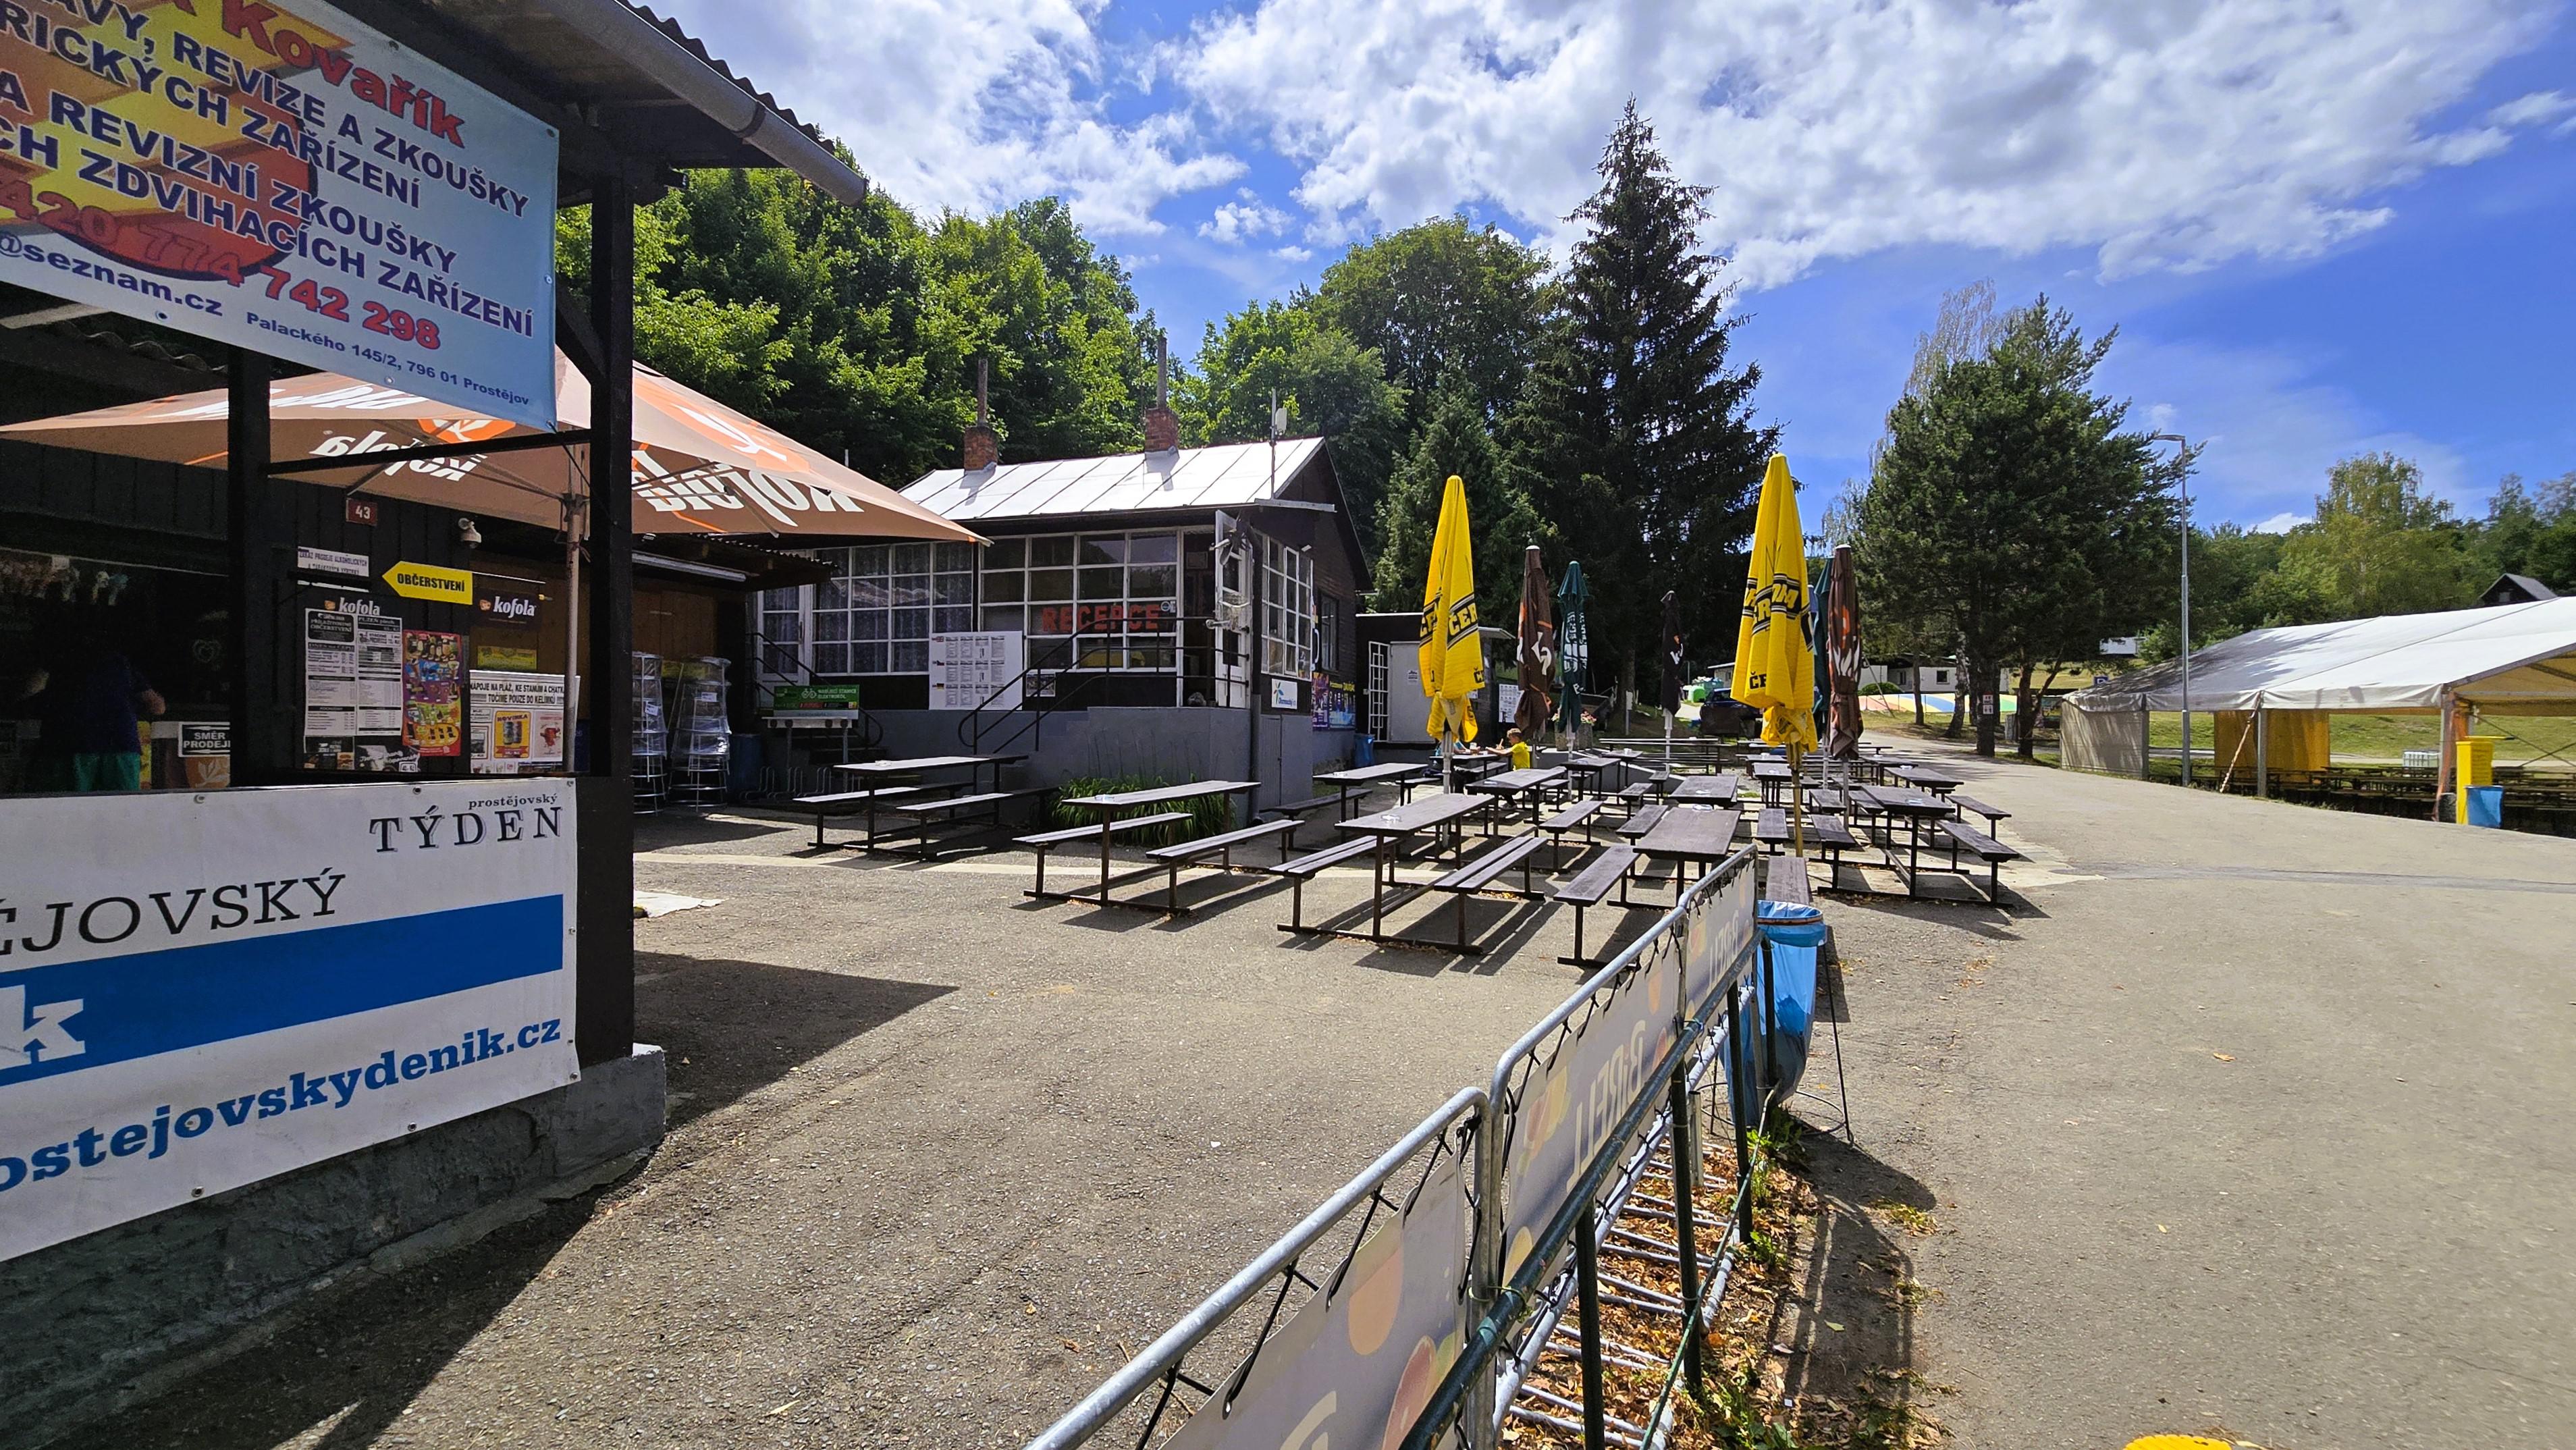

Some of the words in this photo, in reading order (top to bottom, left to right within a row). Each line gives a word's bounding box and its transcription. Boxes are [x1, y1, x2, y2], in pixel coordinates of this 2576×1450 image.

[222, 0, 464, 149] Kovařík
[173, 32, 325, 127] REVIZE
[338, 114, 363, 145] A
[374, 128, 529, 217] ZKOUŠKY
[241, 108, 419, 208] ZAŘÍZENÍ
[51, 90, 259, 200] REVIZNÍ
[271, 182, 456, 273] ZKOUŠKY
[79, 148, 365, 278] ZDVIHACÍCH
[378, 261, 533, 337] ZAŘÍZENÍ
[0, 232, 223, 316] @seznam.cz
[260, 267, 350, 323] 742
[363, 301, 441, 350] 298
[246, 311, 346, 352] Palackého
[351, 344, 402, 370] 145/2,
[406, 360, 435, 378] 796
[440, 369, 458, 385] 01
[464, 377, 529, 405] Prostějov
[355, 506, 371, 520] 43
[397, 572, 465, 592] OBČERSTVENÍ
[339, 597, 380, 616] kofola
[493, 596, 535, 618] kofola
[1042, 604, 1160, 633] RECEPCE
[491, 683, 498, 691] NA
[515, 684, 522, 692] KE
[509, 693, 525, 703] POUZE
[527, 695, 533, 703] DO
[497, 714, 528, 722] NOVINKA
[194, 730, 225, 740] SMĚR
[468, 793, 558, 810] prostějovský
[369, 805, 562, 852] TÝDEN
